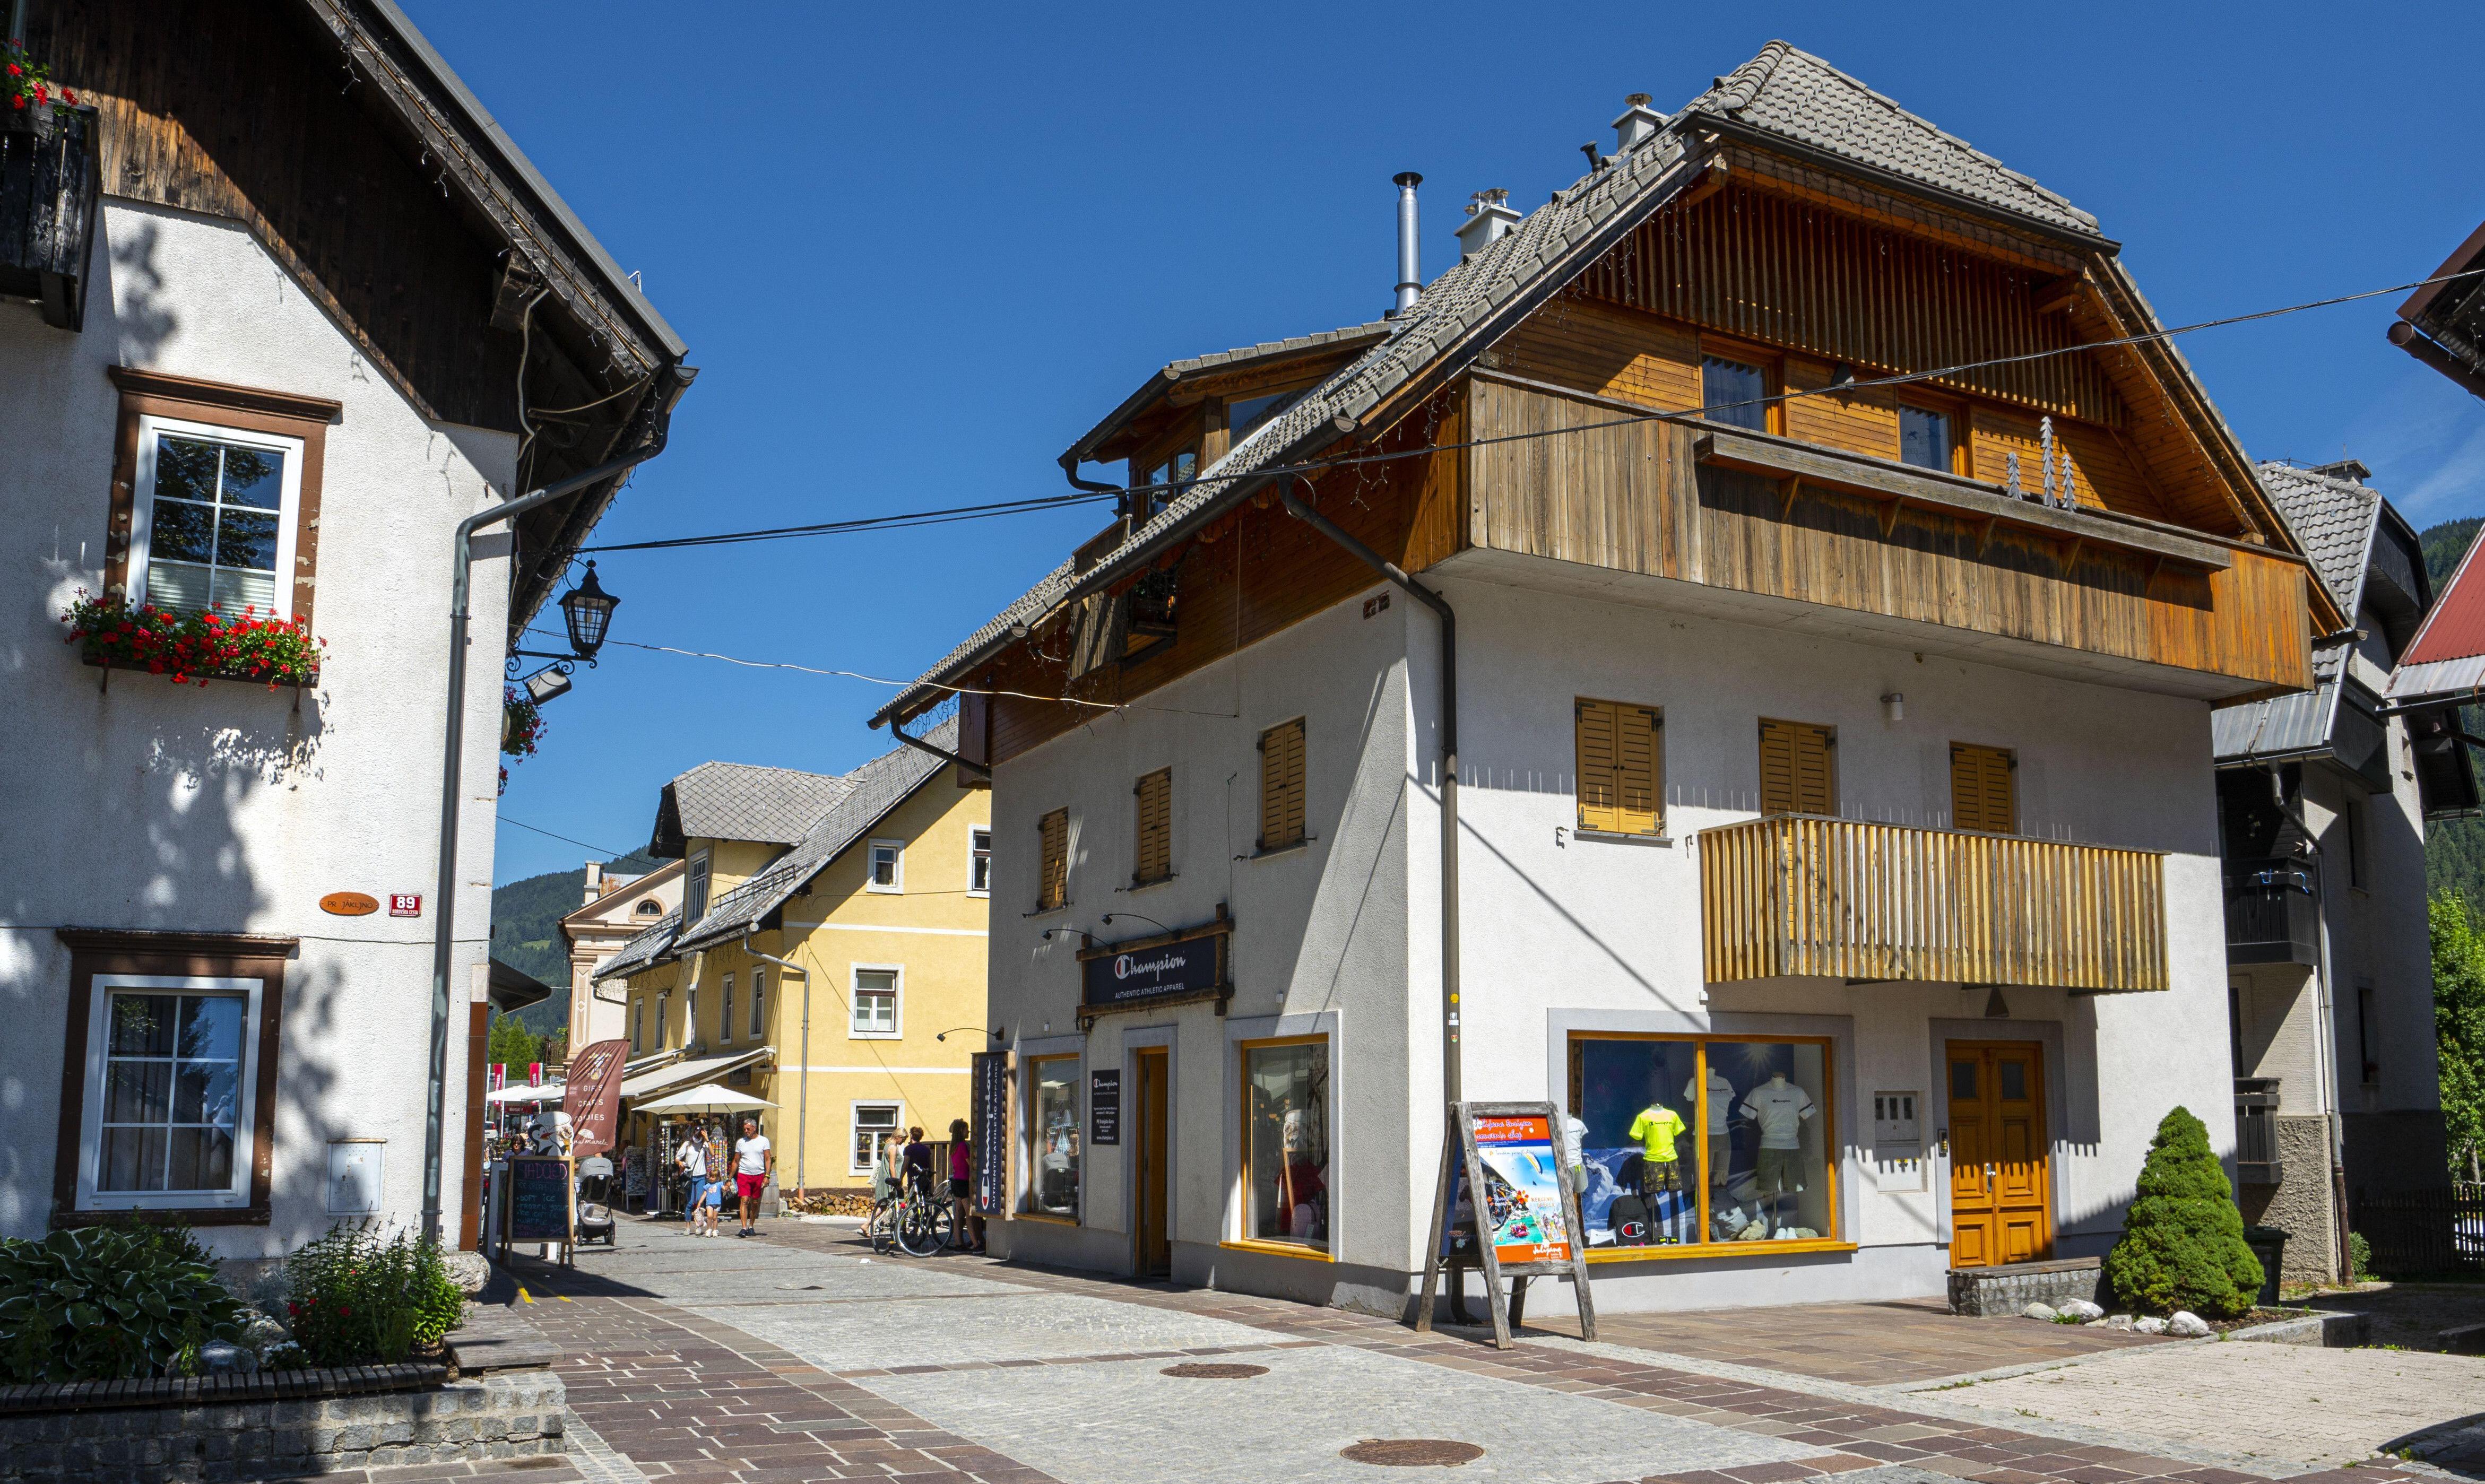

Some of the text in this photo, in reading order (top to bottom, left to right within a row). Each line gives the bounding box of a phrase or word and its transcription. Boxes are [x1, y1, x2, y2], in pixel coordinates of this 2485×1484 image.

[397, 896, 415, 908] 89
[1115, 954, 1186, 981] Champion
[1115, 983, 1184, 999] AUTHENTIC ATHLETIC APPAREL
[1093, 1078, 1118, 1090] Champion
[981, 1058, 993, 1210] Champion
